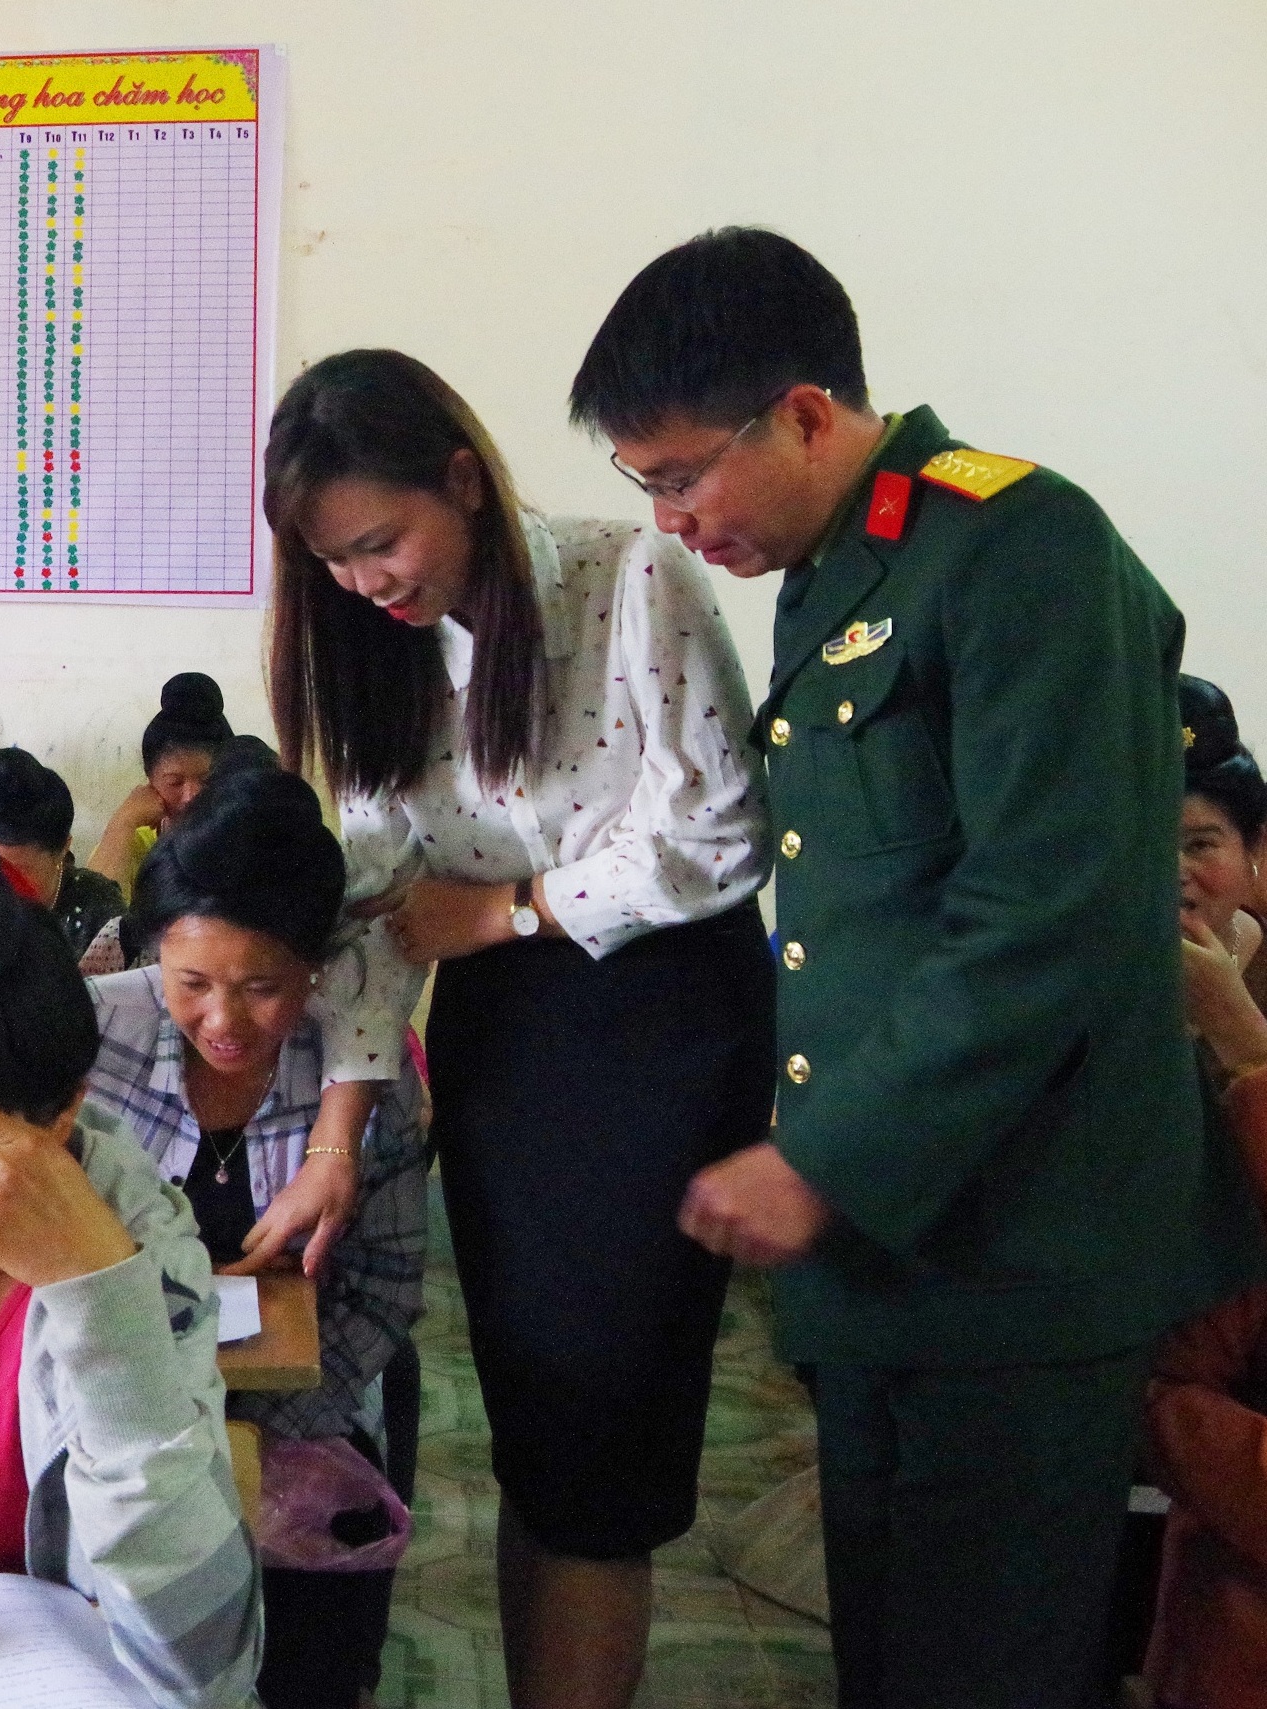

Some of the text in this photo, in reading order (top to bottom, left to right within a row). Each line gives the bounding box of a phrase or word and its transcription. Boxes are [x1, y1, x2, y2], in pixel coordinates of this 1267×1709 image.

[32, 77, 86, 108] hoa
[93, 75, 171, 106] chăm
[176, 73, 225, 110] học
[20, 132, 32, 143] T9
[45, 132, 61, 142] T10
[71, 131, 87, 142] T11
[98, 130, 115, 141] T12
[128, 130, 139, 140] T1
[154, 129, 166, 140] T2
[182, 129, 195, 139] T3
[209, 128, 222, 139] T4
[236, 127, 249, 138] T5
